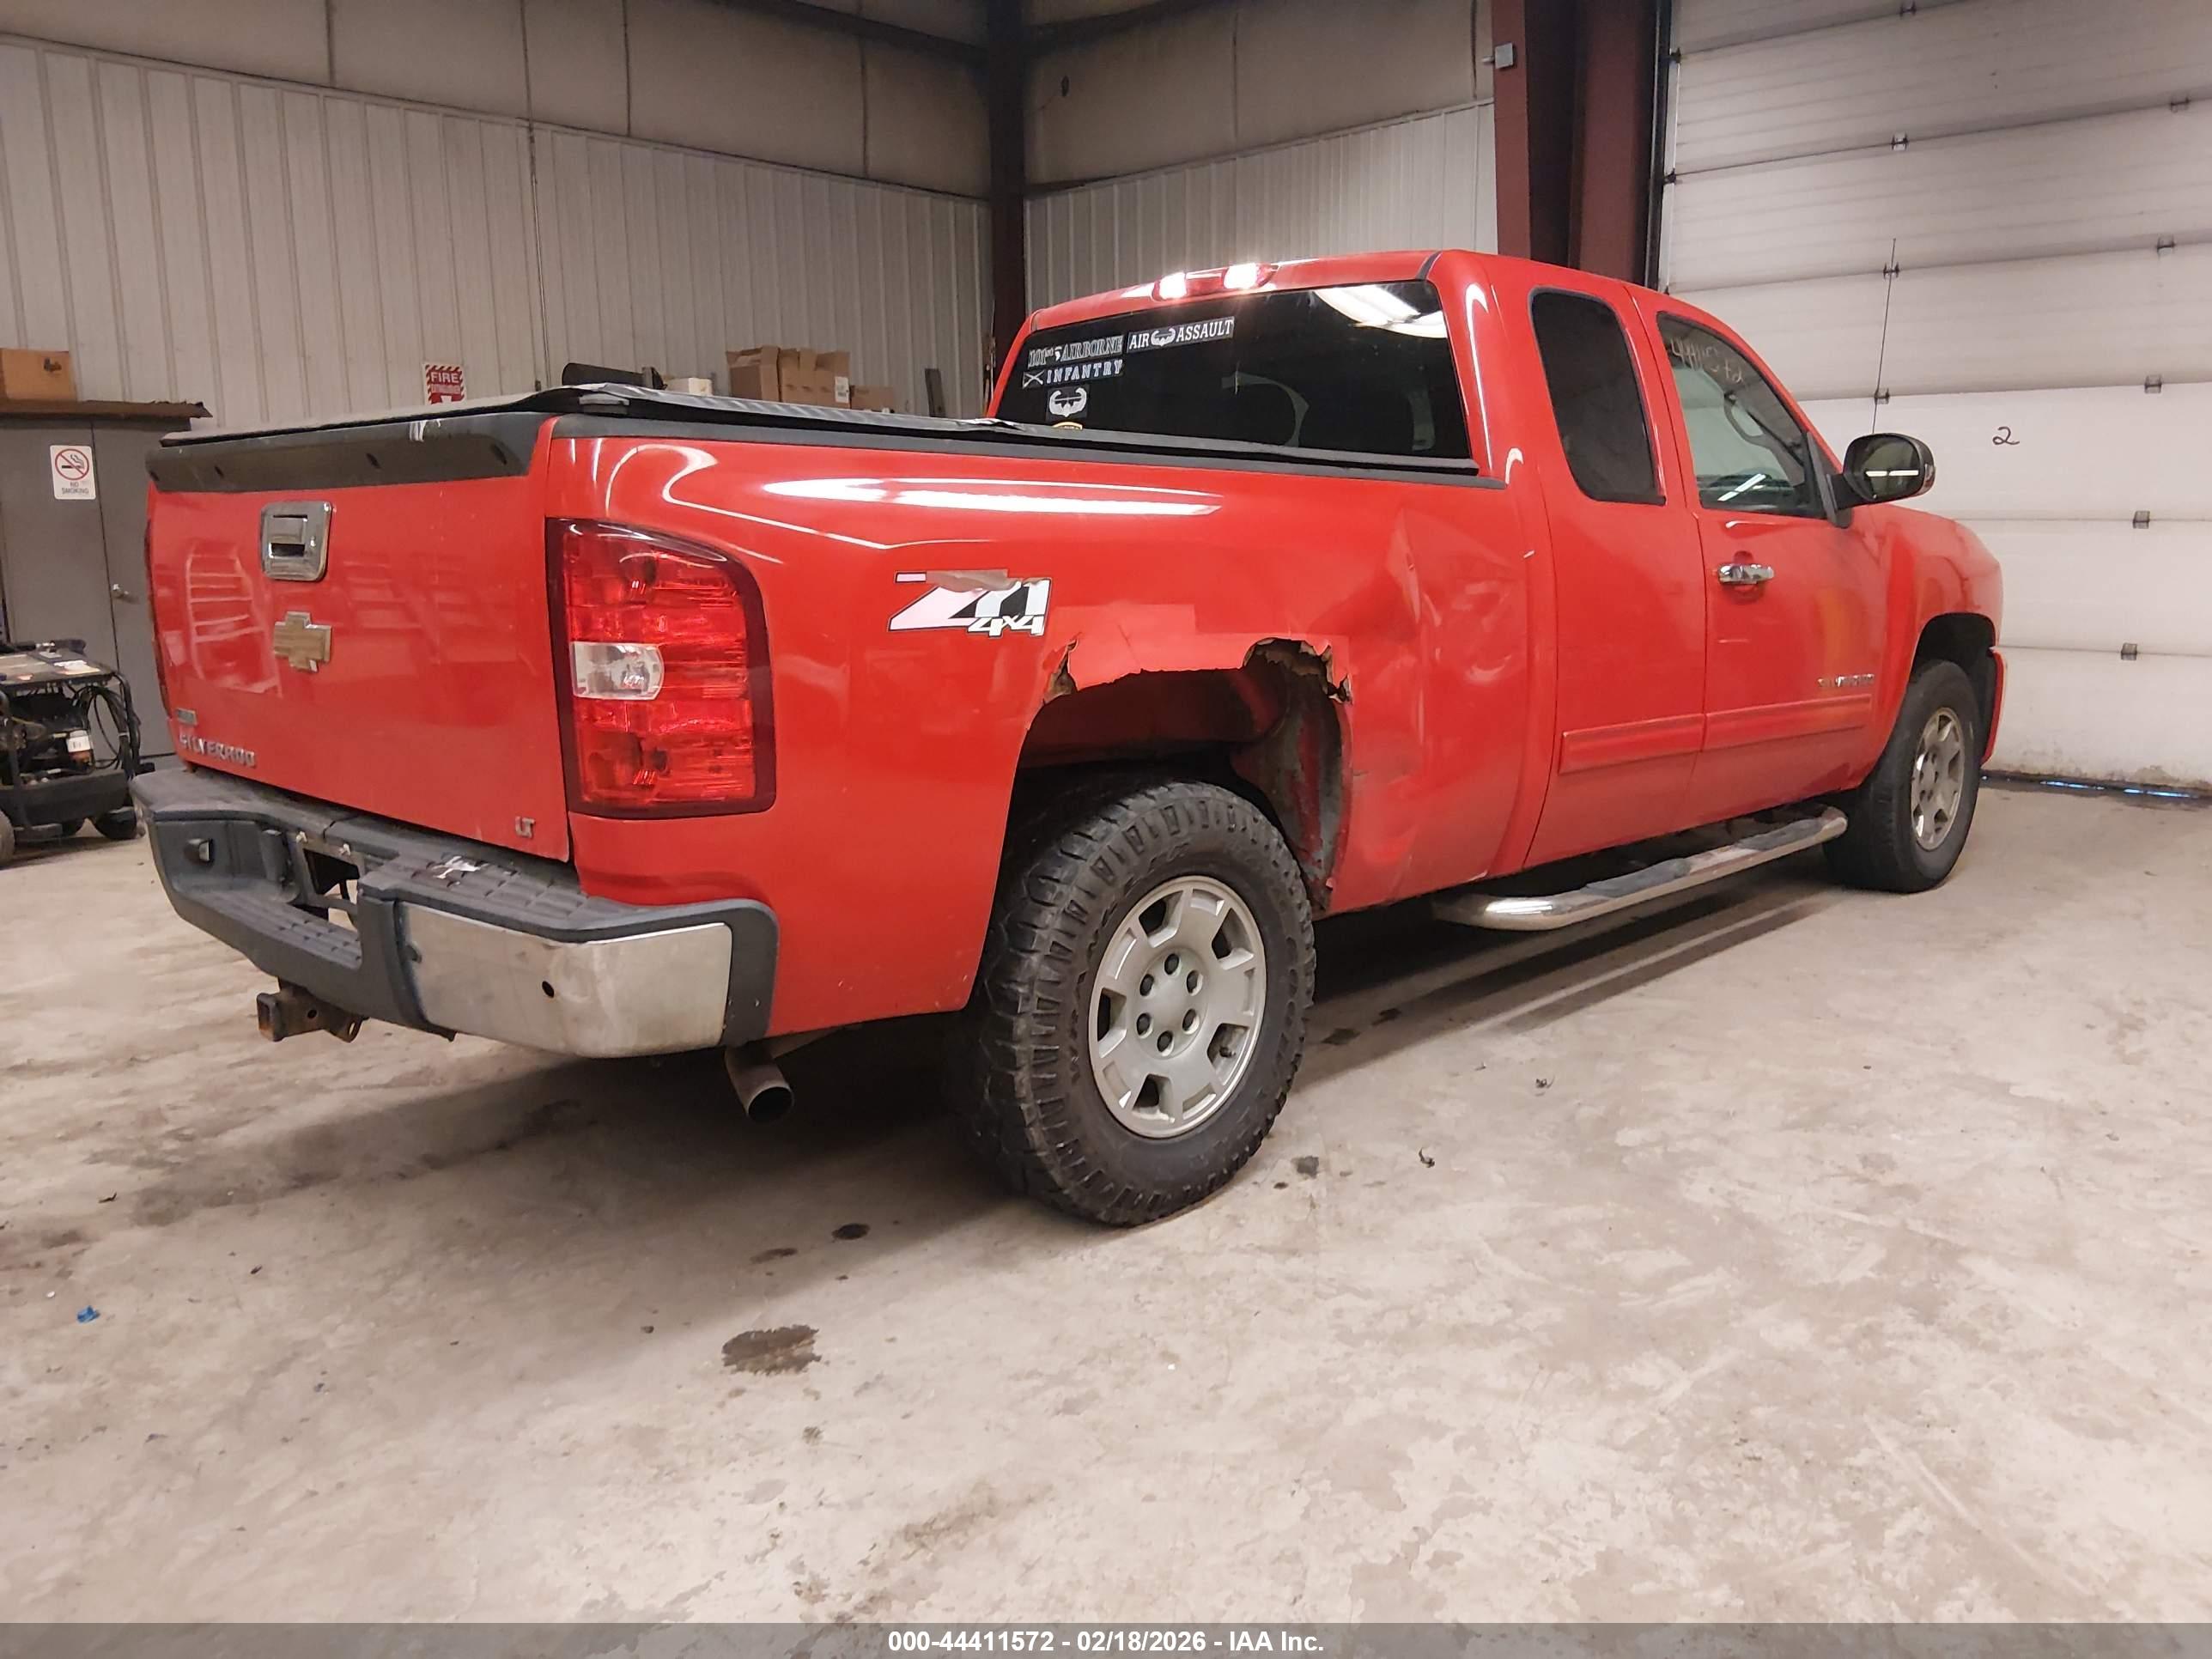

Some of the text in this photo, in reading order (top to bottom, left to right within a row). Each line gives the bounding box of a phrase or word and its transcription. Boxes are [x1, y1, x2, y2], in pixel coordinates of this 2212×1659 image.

[1128, 319, 1234, 349] AIR ASSAULT
[1060, 335, 1123, 362] AIRBORNE
[430, 371, 459, 384] FIRE
[1046, 359, 1123, 384] INFANTRY
[1992, 426, 2021, 446] 2
[515, 816, 535, 838] LT
